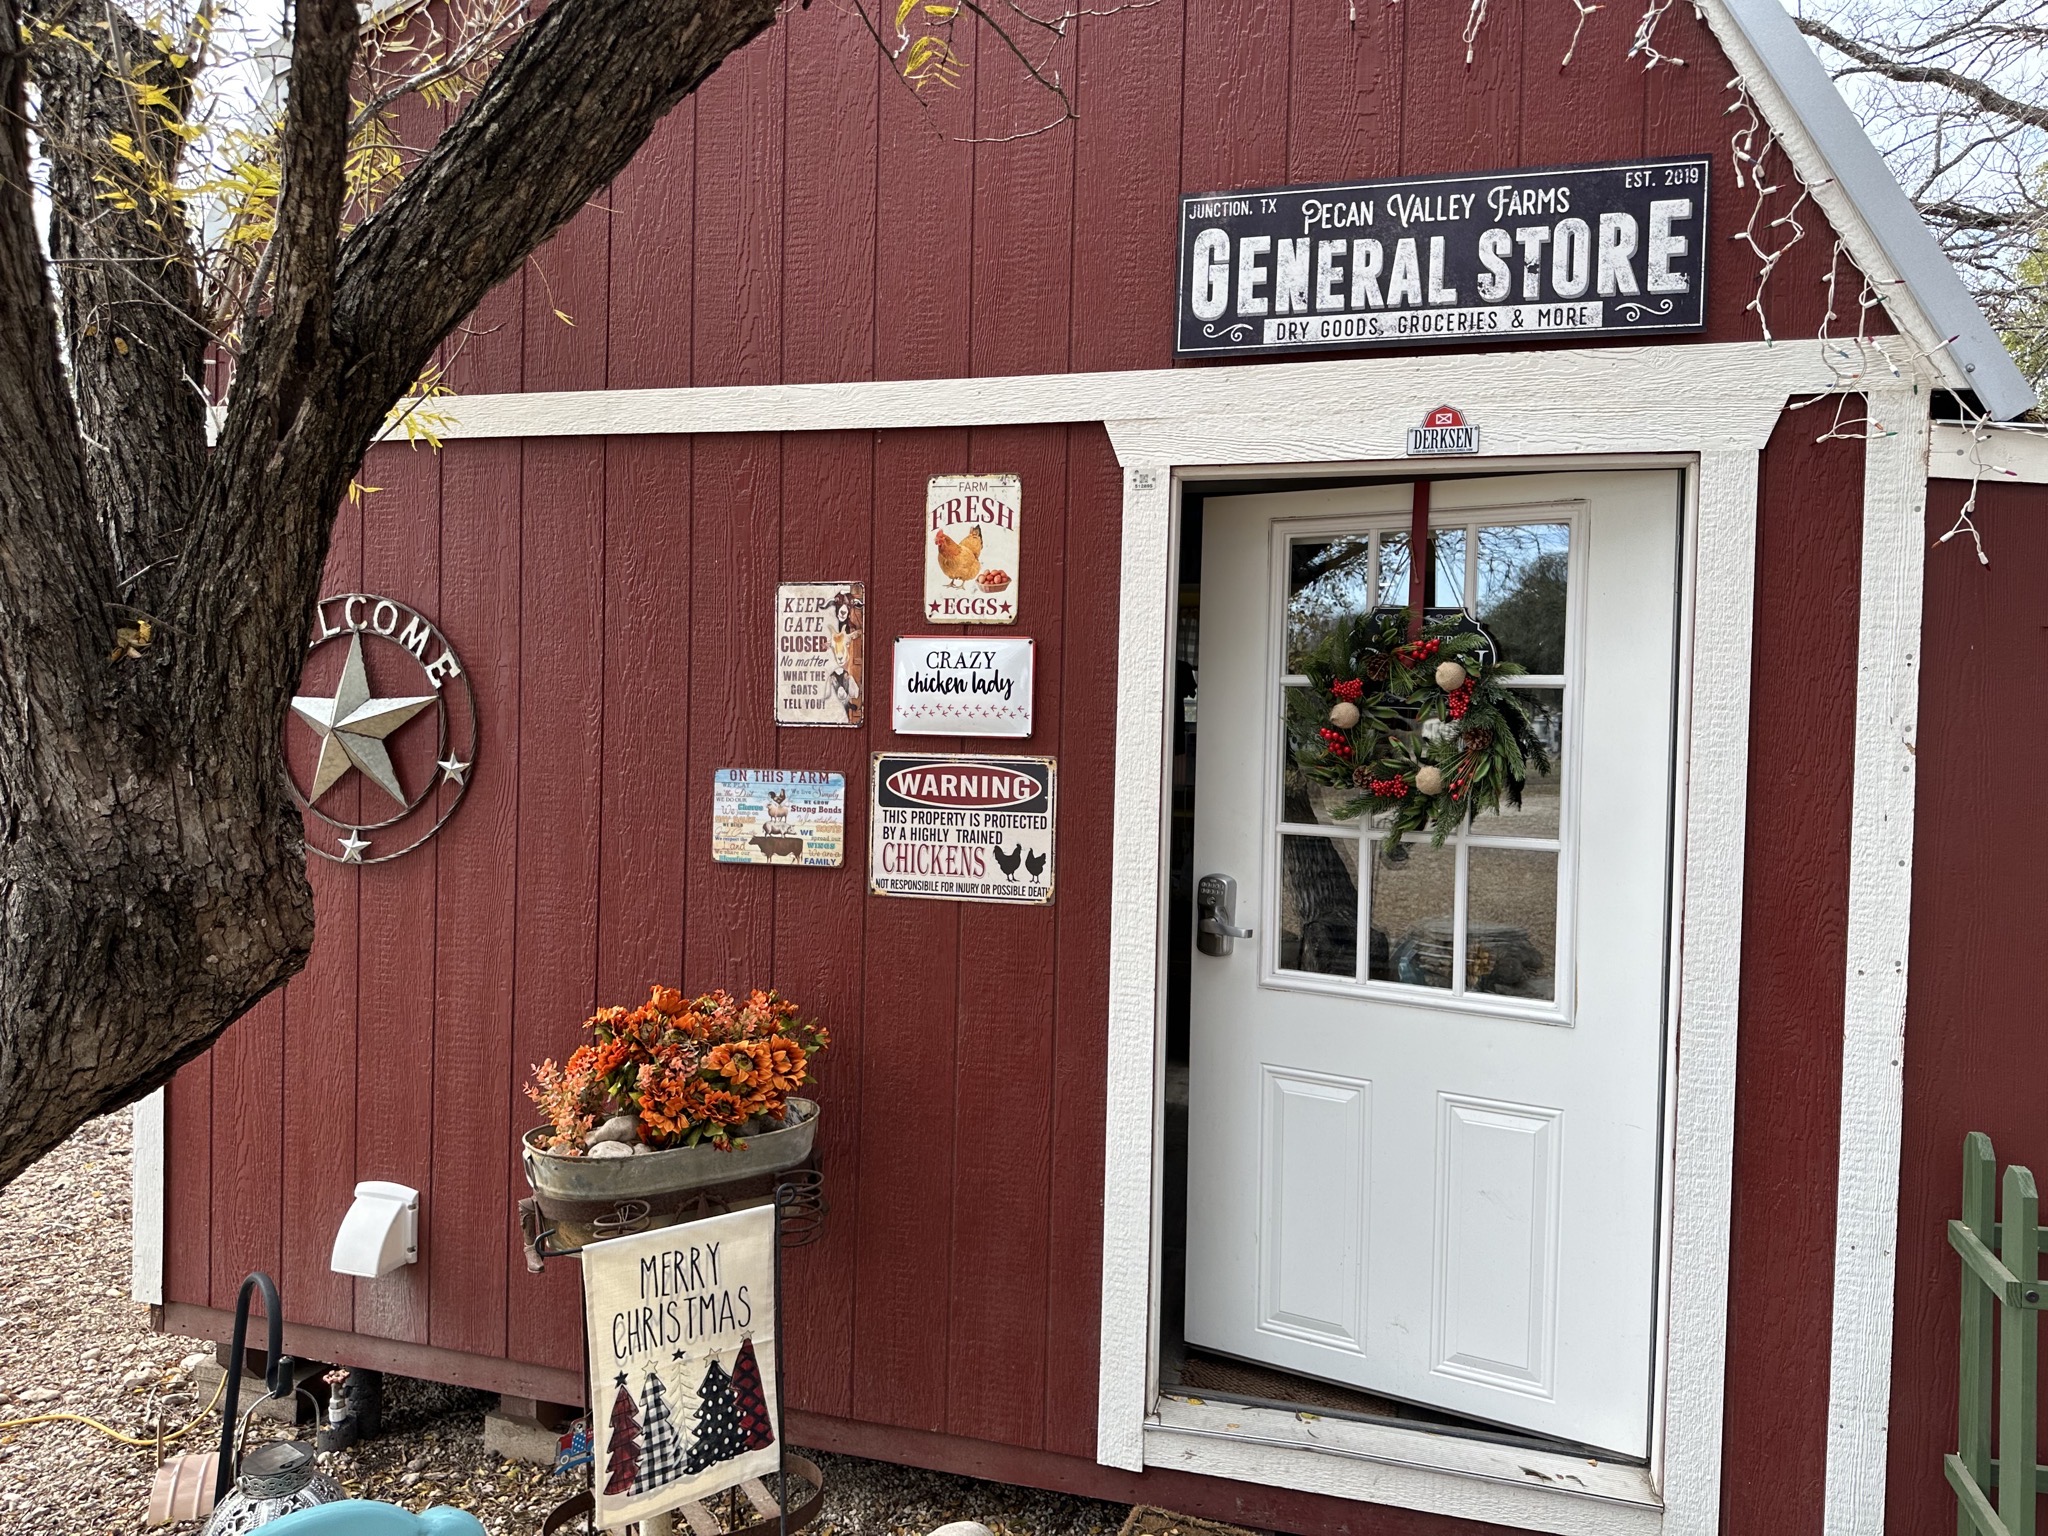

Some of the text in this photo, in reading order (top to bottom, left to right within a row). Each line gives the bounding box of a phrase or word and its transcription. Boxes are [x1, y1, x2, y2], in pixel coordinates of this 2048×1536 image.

[1625, 167, 1699, 188] EST. 2019
[1261, 199, 1277, 214] TX
[1191, 198, 1693, 322] GENERAL STORE
[1276, 321, 1310, 341] DRY
[1398, 311, 1498, 334] GROCERIES
[1511, 309, 1524, 328] &
[1538, 306, 1588, 327] MORE
[1413, 427, 1473, 450] DERKSEN
[958, 481, 988, 492] FARM
[931, 495, 1015, 532] FRESH
[784, 598, 825, 613] KEEP
[943, 597, 998, 616] EGGS
[784, 617, 824, 632] GATE
[310, 596, 462, 690] LCOME
[781, 636, 828, 652] CLOSED
[780, 656, 828, 667] No matter
[926, 650, 997, 670] CRAZY
[783, 671, 825, 681] WHAT THE
[907, 669, 1014, 700] chicken lady
[790, 684, 818, 695] GOATS
[784, 699, 825, 709] TELL YOU!
[730, 770, 829, 784] ON THIS FARM
[897, 773, 1031, 799] WARNING
[812, 785, 839, 798] Simply
[791, 805, 816, 814] Strong
[883, 810, 1047, 829] THIS PROPERTY IS PROTECTED
[883, 826, 1002, 845] BY A HIGHLY TRAINED
[722, 842, 745, 850] Land
[883, 842, 986, 878] CHICKENS
[876, 878, 889, 888] NOT
[941, 882, 954, 892] FOR
[956, 883, 979, 893] INJURY
[981, 884, 991, 894] OR
[993, 885, 1026, 896] POSSIBLE
[641, 1241, 720, 1299] MERRY
[612, 1285, 752, 1360] CHRISTMAS
